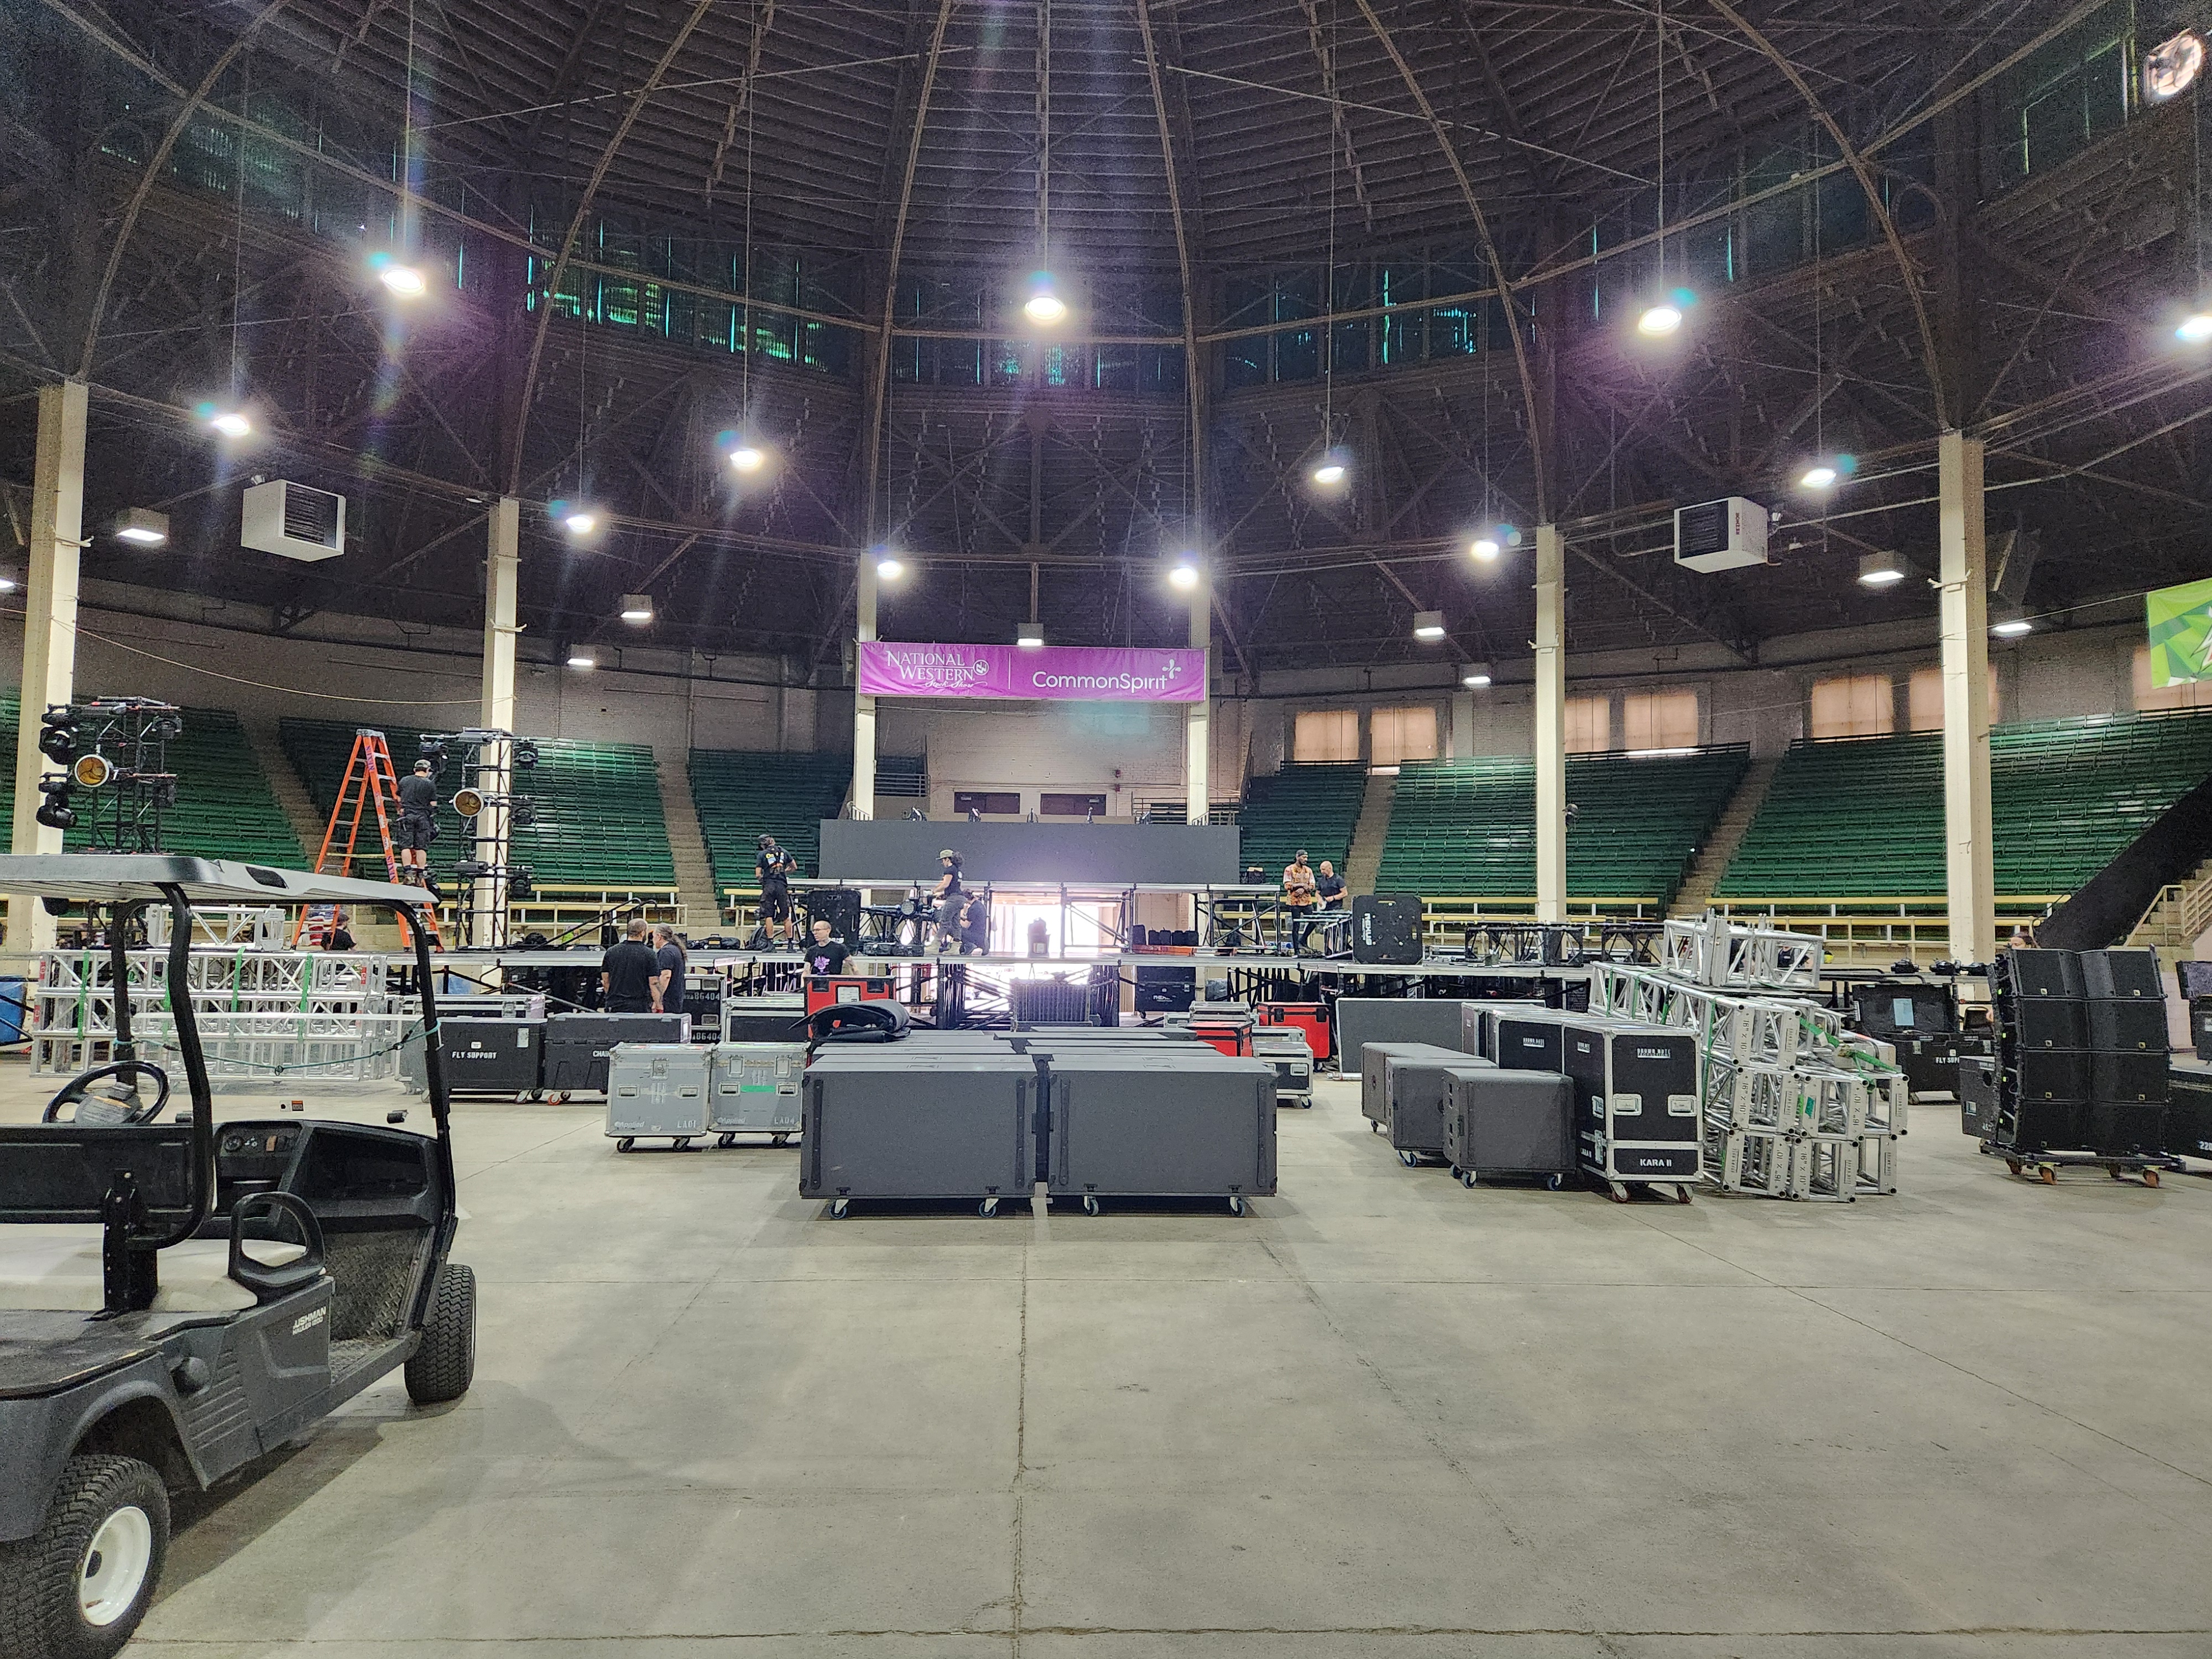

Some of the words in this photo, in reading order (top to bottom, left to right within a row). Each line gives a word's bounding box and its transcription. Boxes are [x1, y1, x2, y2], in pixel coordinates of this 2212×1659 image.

[886, 651, 965, 667] NATIONAL
[900, 665, 974, 681] WESTERN
[925, 678, 948, 688] Stock
[1032, 671, 1168, 693] CommonSpirit
[695, 992, 720, 1000] 86404
[1640, 1159, 1665, 1167] KARA
[293, 1322, 312, 1335] HAULER
